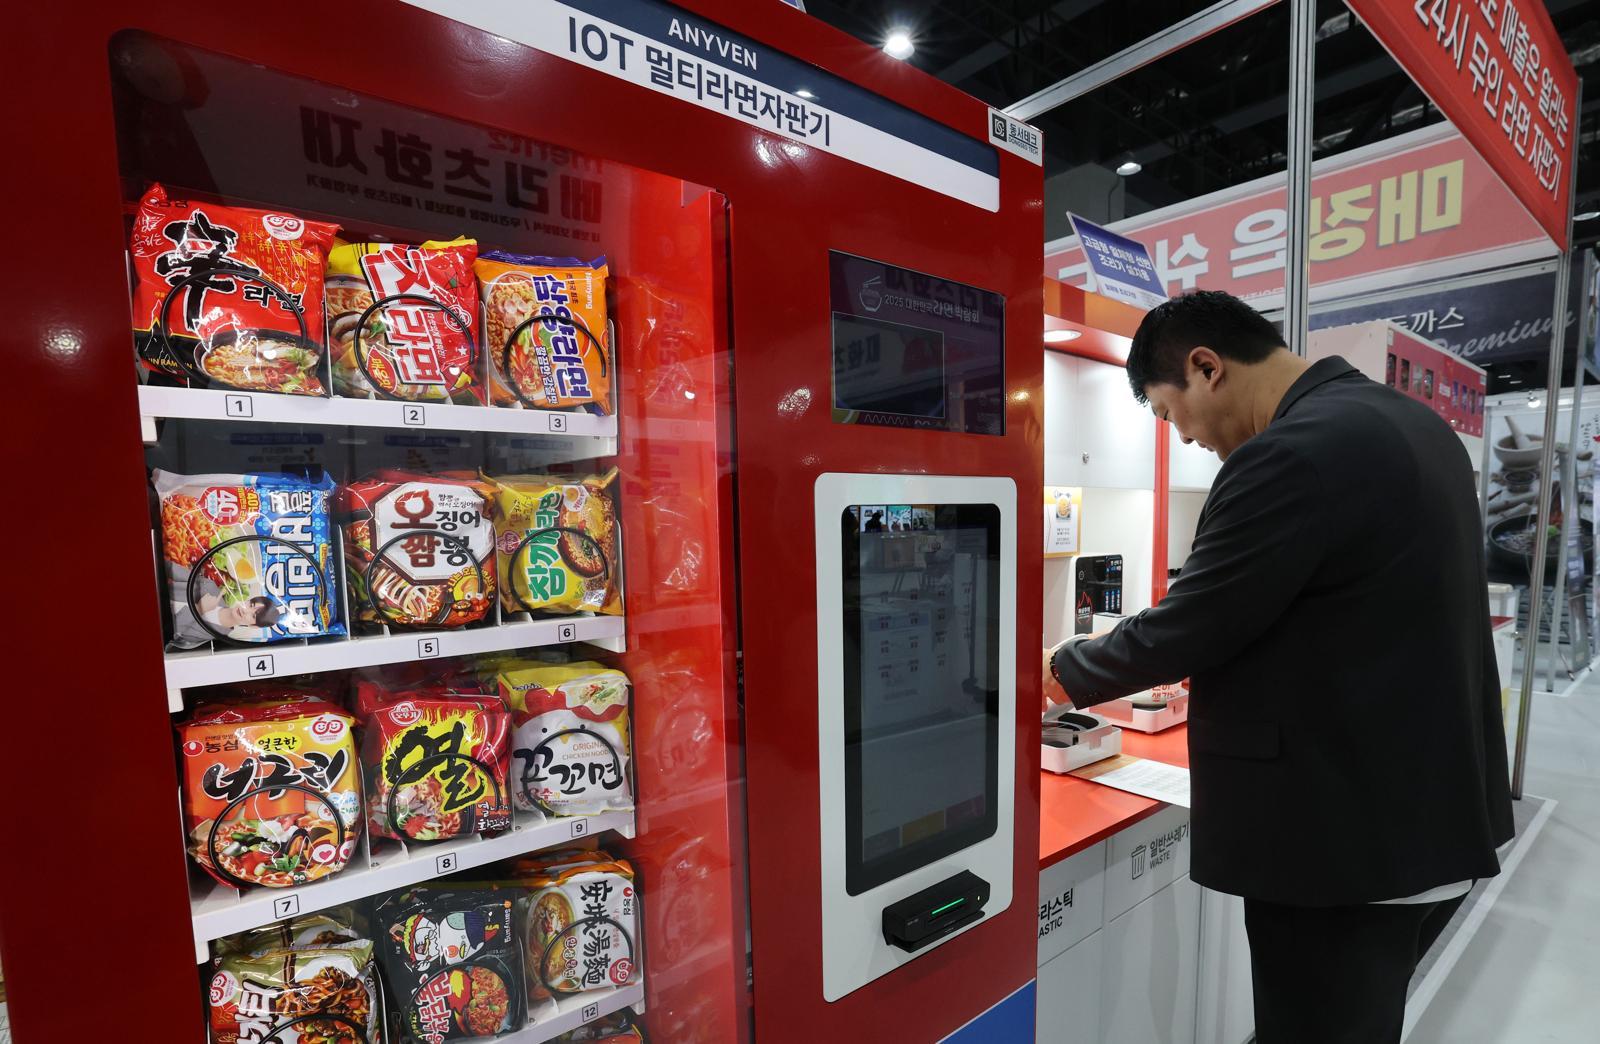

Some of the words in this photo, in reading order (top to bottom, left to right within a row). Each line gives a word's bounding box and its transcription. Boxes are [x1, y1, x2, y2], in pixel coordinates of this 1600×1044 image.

[668, 18, 757, 70] ANYVEN
[569, 16, 634, 70] IOT
[646, 45, 830, 146] 멀티라면자판기
[1499, 0, 1540, 97] 매출은
[1539, 67, 1568, 148] 열리는
[1468, 31, 1503, 119] 무인
[1501, 81, 1531, 157] 라면
[1528, 122, 1562, 201] 자판기
[532, 274, 591, 398] 삼양라면
[233, 399, 244, 414] 1
[409, 410, 419, 421] 2
[554, 418, 562, 428] 3
[390, 489, 481, 532] 오징어
[525, 491, 567, 601] 참깨라면
[563, 628, 571, 637] 6
[424, 642, 433, 653] 5
[256, 659, 267, 671] 4
[204, 739, 239, 754] 농심
[258, 735, 298, 751] 얼큰한
[512, 744, 624, 796] 꼬꼬면
[575, 823, 583, 833] 9
[1150, 820, 1189, 858] 일반쓰레기
[442, 858, 451, 869] 8
[1150, 850, 1171, 869] WASTE
[283, 901, 291, 912] 7
[623, 898, 633, 916] 농심
[1038, 887, 1073, 921] 라스틱
[503, 908, 512, 943] Samyang
[1038, 915, 1063, 939] ASTIC
[411, 970, 452, 1044] 불닭볶음
[584, 1007, 596, 1017] 12
